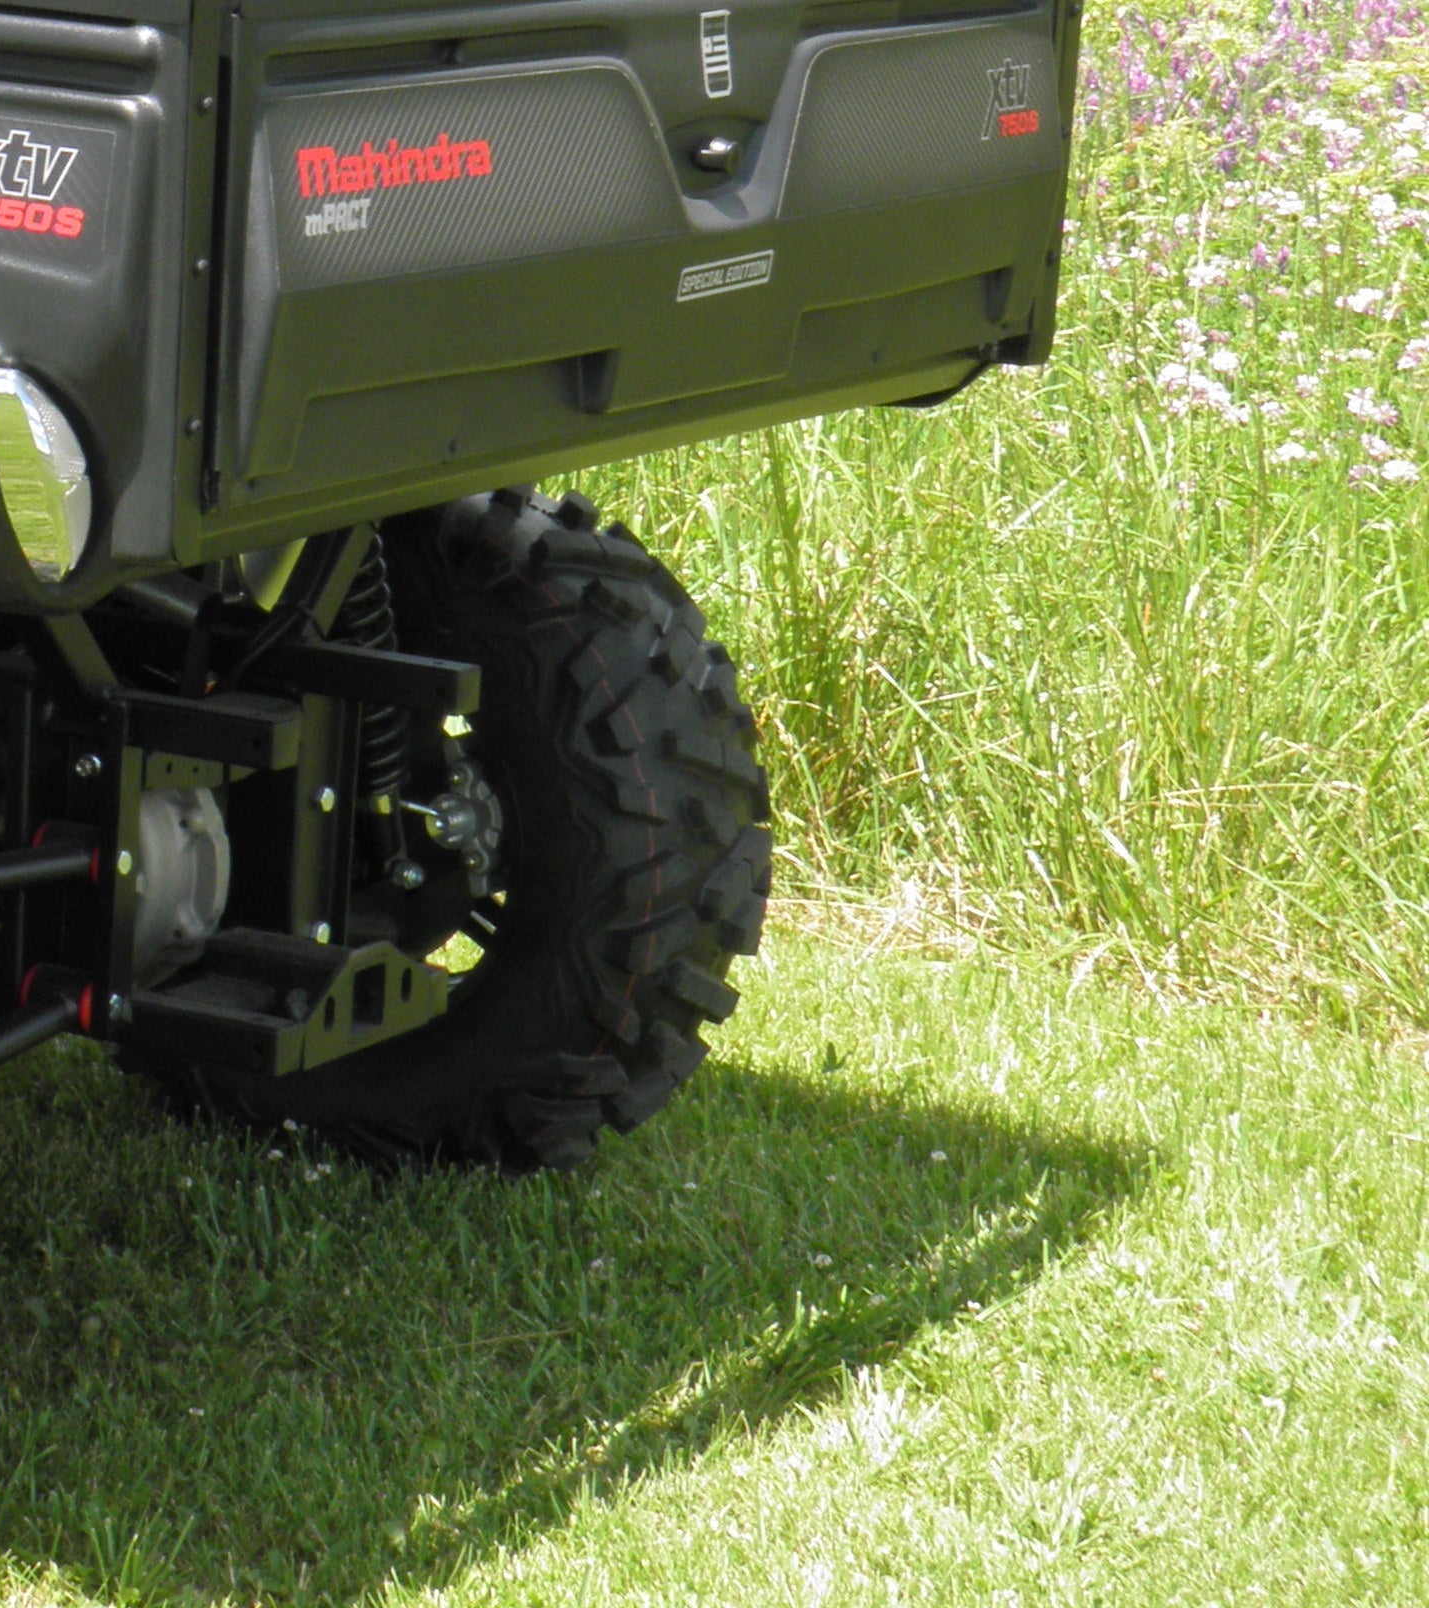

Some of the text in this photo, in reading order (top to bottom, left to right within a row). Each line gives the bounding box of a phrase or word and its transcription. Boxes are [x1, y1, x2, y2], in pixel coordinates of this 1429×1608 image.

[297, 132, 492, 197] Mahindra
[305, 198, 371, 236] mPACT
[682, 259, 769, 292] SPECIAL EDITION
